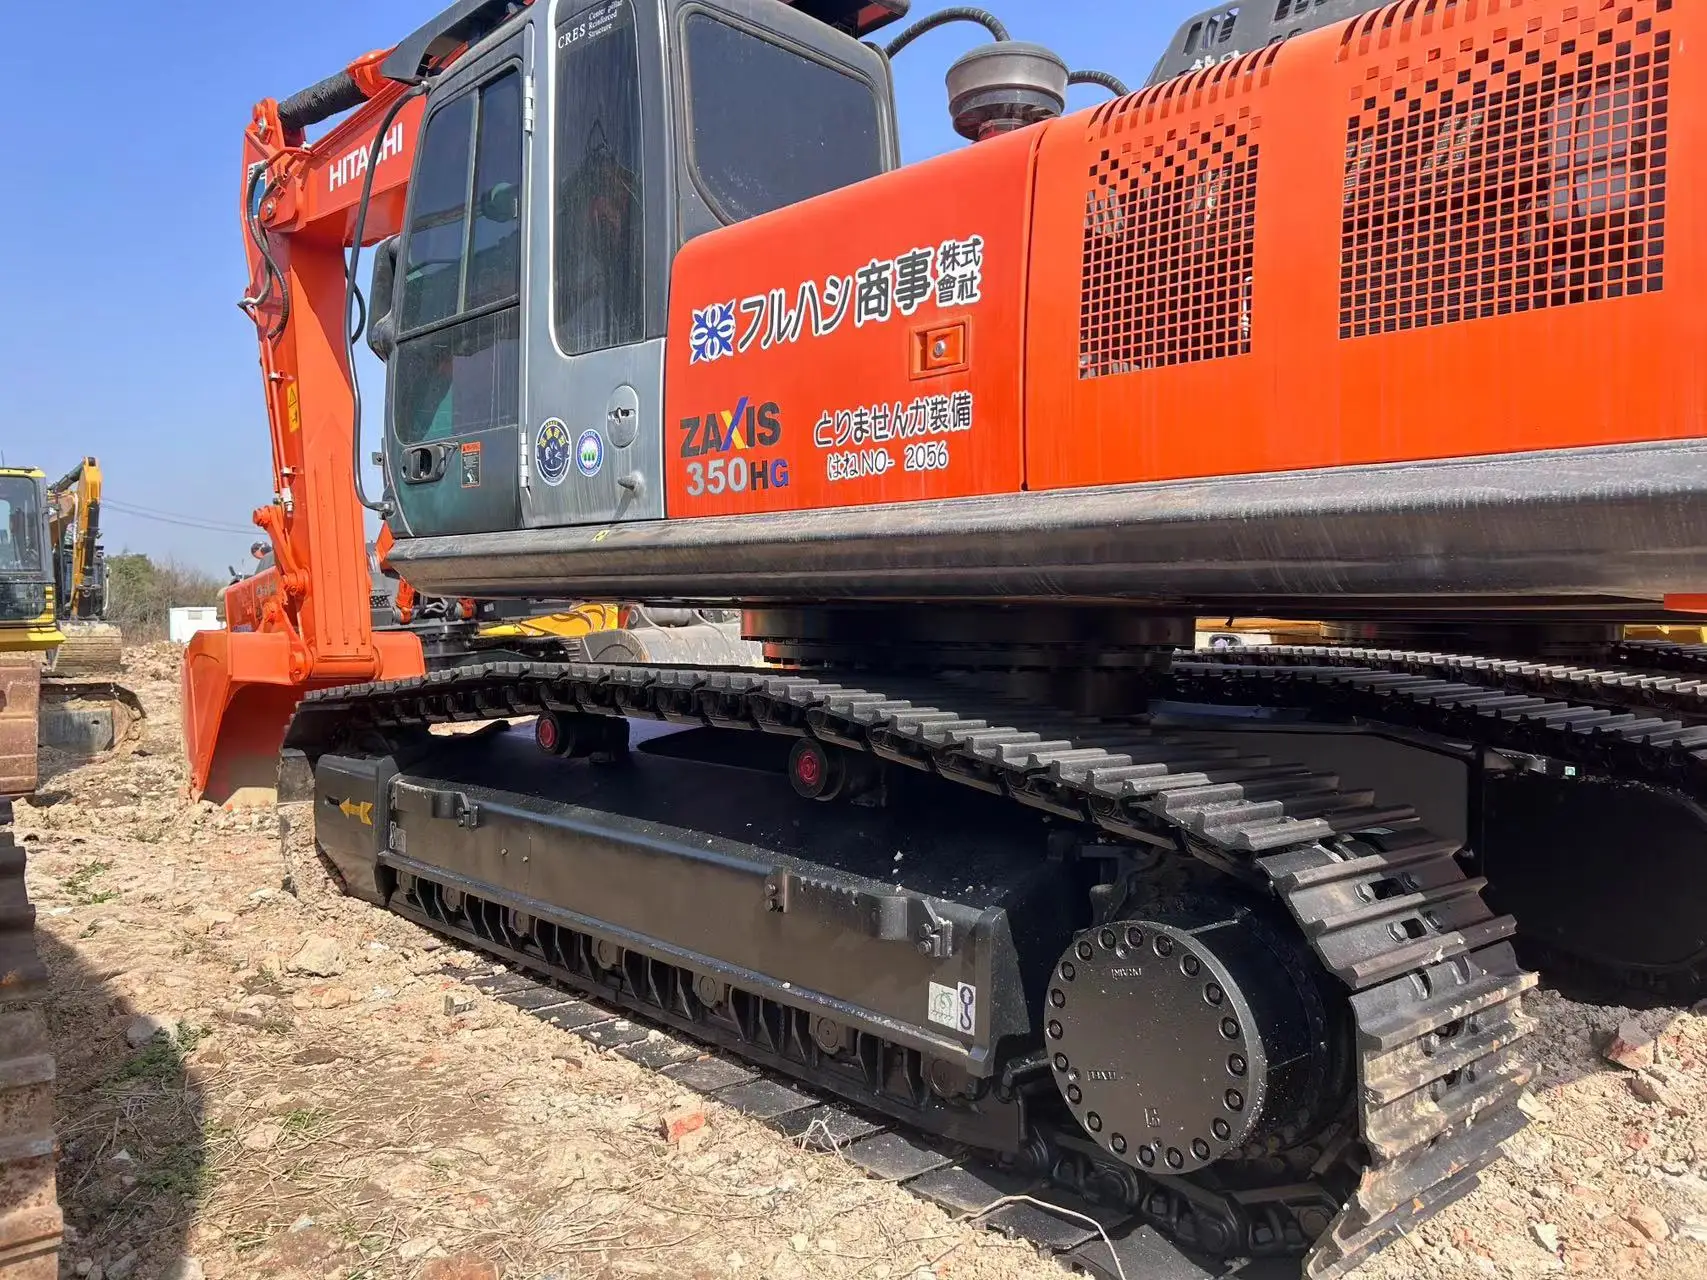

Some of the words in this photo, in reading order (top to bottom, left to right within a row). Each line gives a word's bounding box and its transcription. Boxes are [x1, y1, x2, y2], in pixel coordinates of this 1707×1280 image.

[588, 7, 606, 21] Center
[557, 23, 586, 49] CRES
[587, 23, 613, 39] Structure
[738, 249, 933, 350] フルハシ商事
[679, 395, 782, 459] ZAXIS
[905, 443, 948, 470] 2056
[686, 456, 789, 497] 350HG
